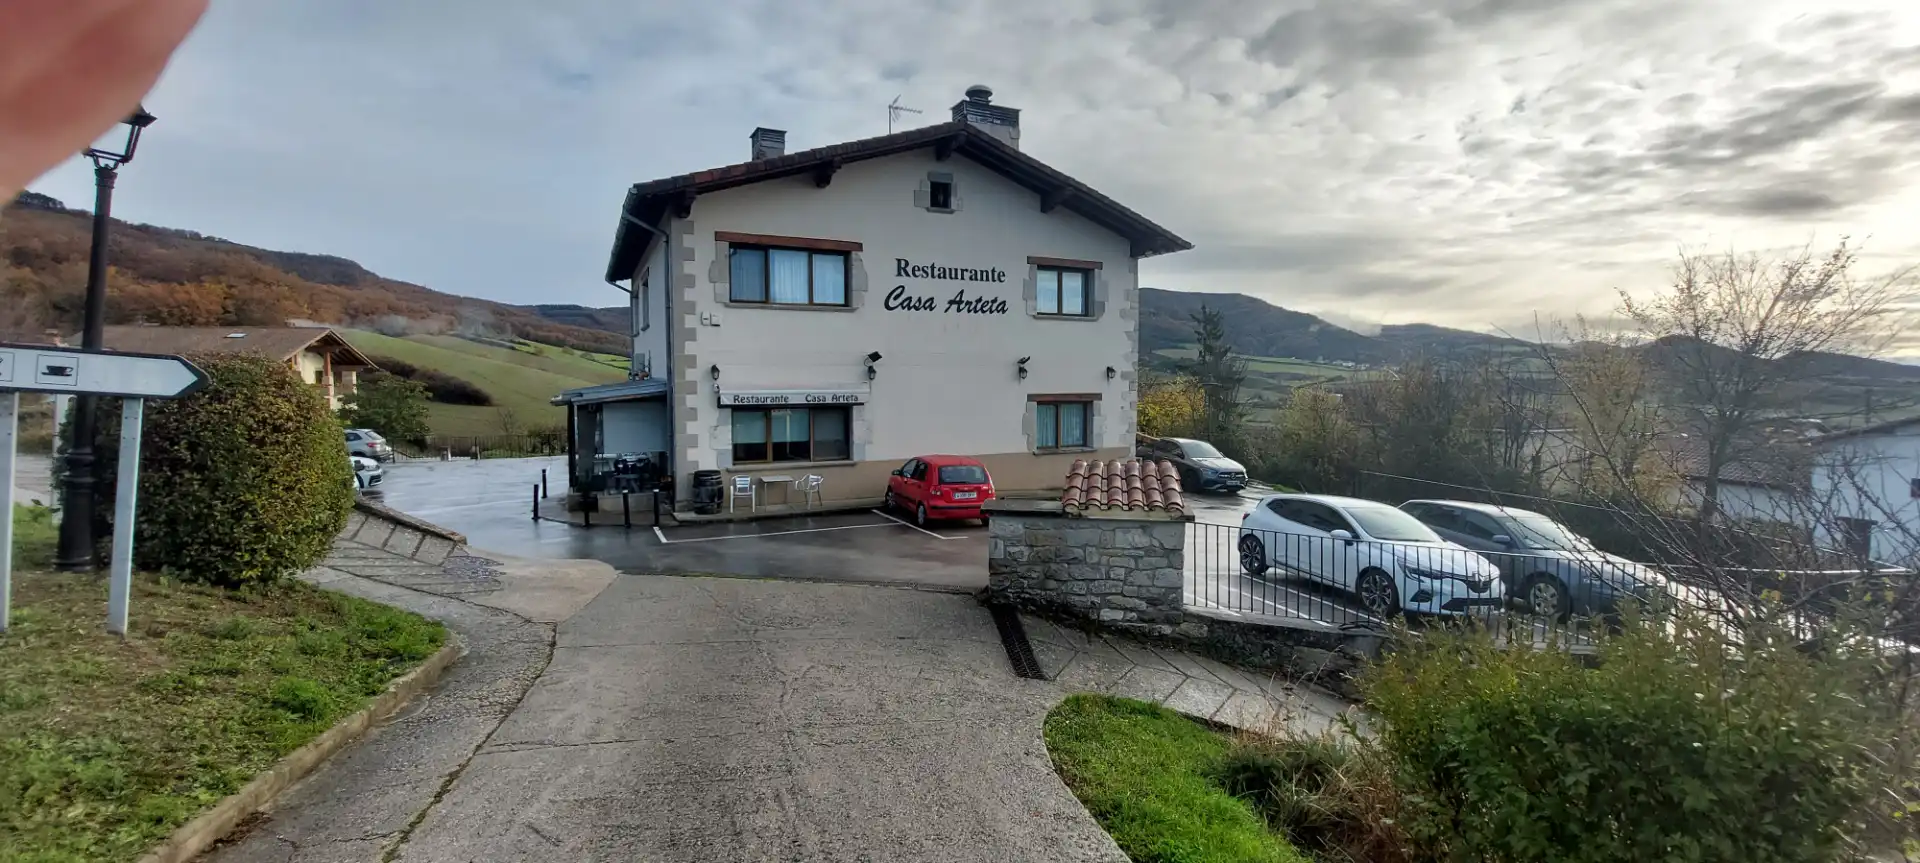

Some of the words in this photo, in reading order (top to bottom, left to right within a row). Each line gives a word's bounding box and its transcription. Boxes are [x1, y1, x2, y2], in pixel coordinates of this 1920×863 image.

[895, 258, 1006, 283] Restaurante
[884, 285, 937, 311] Casa
[944, 289, 1008, 314] Arteta
[733, 394, 789, 404] Restaurante
[805, 393, 826, 403] Casa
[831, 393, 859, 402] Arteta
